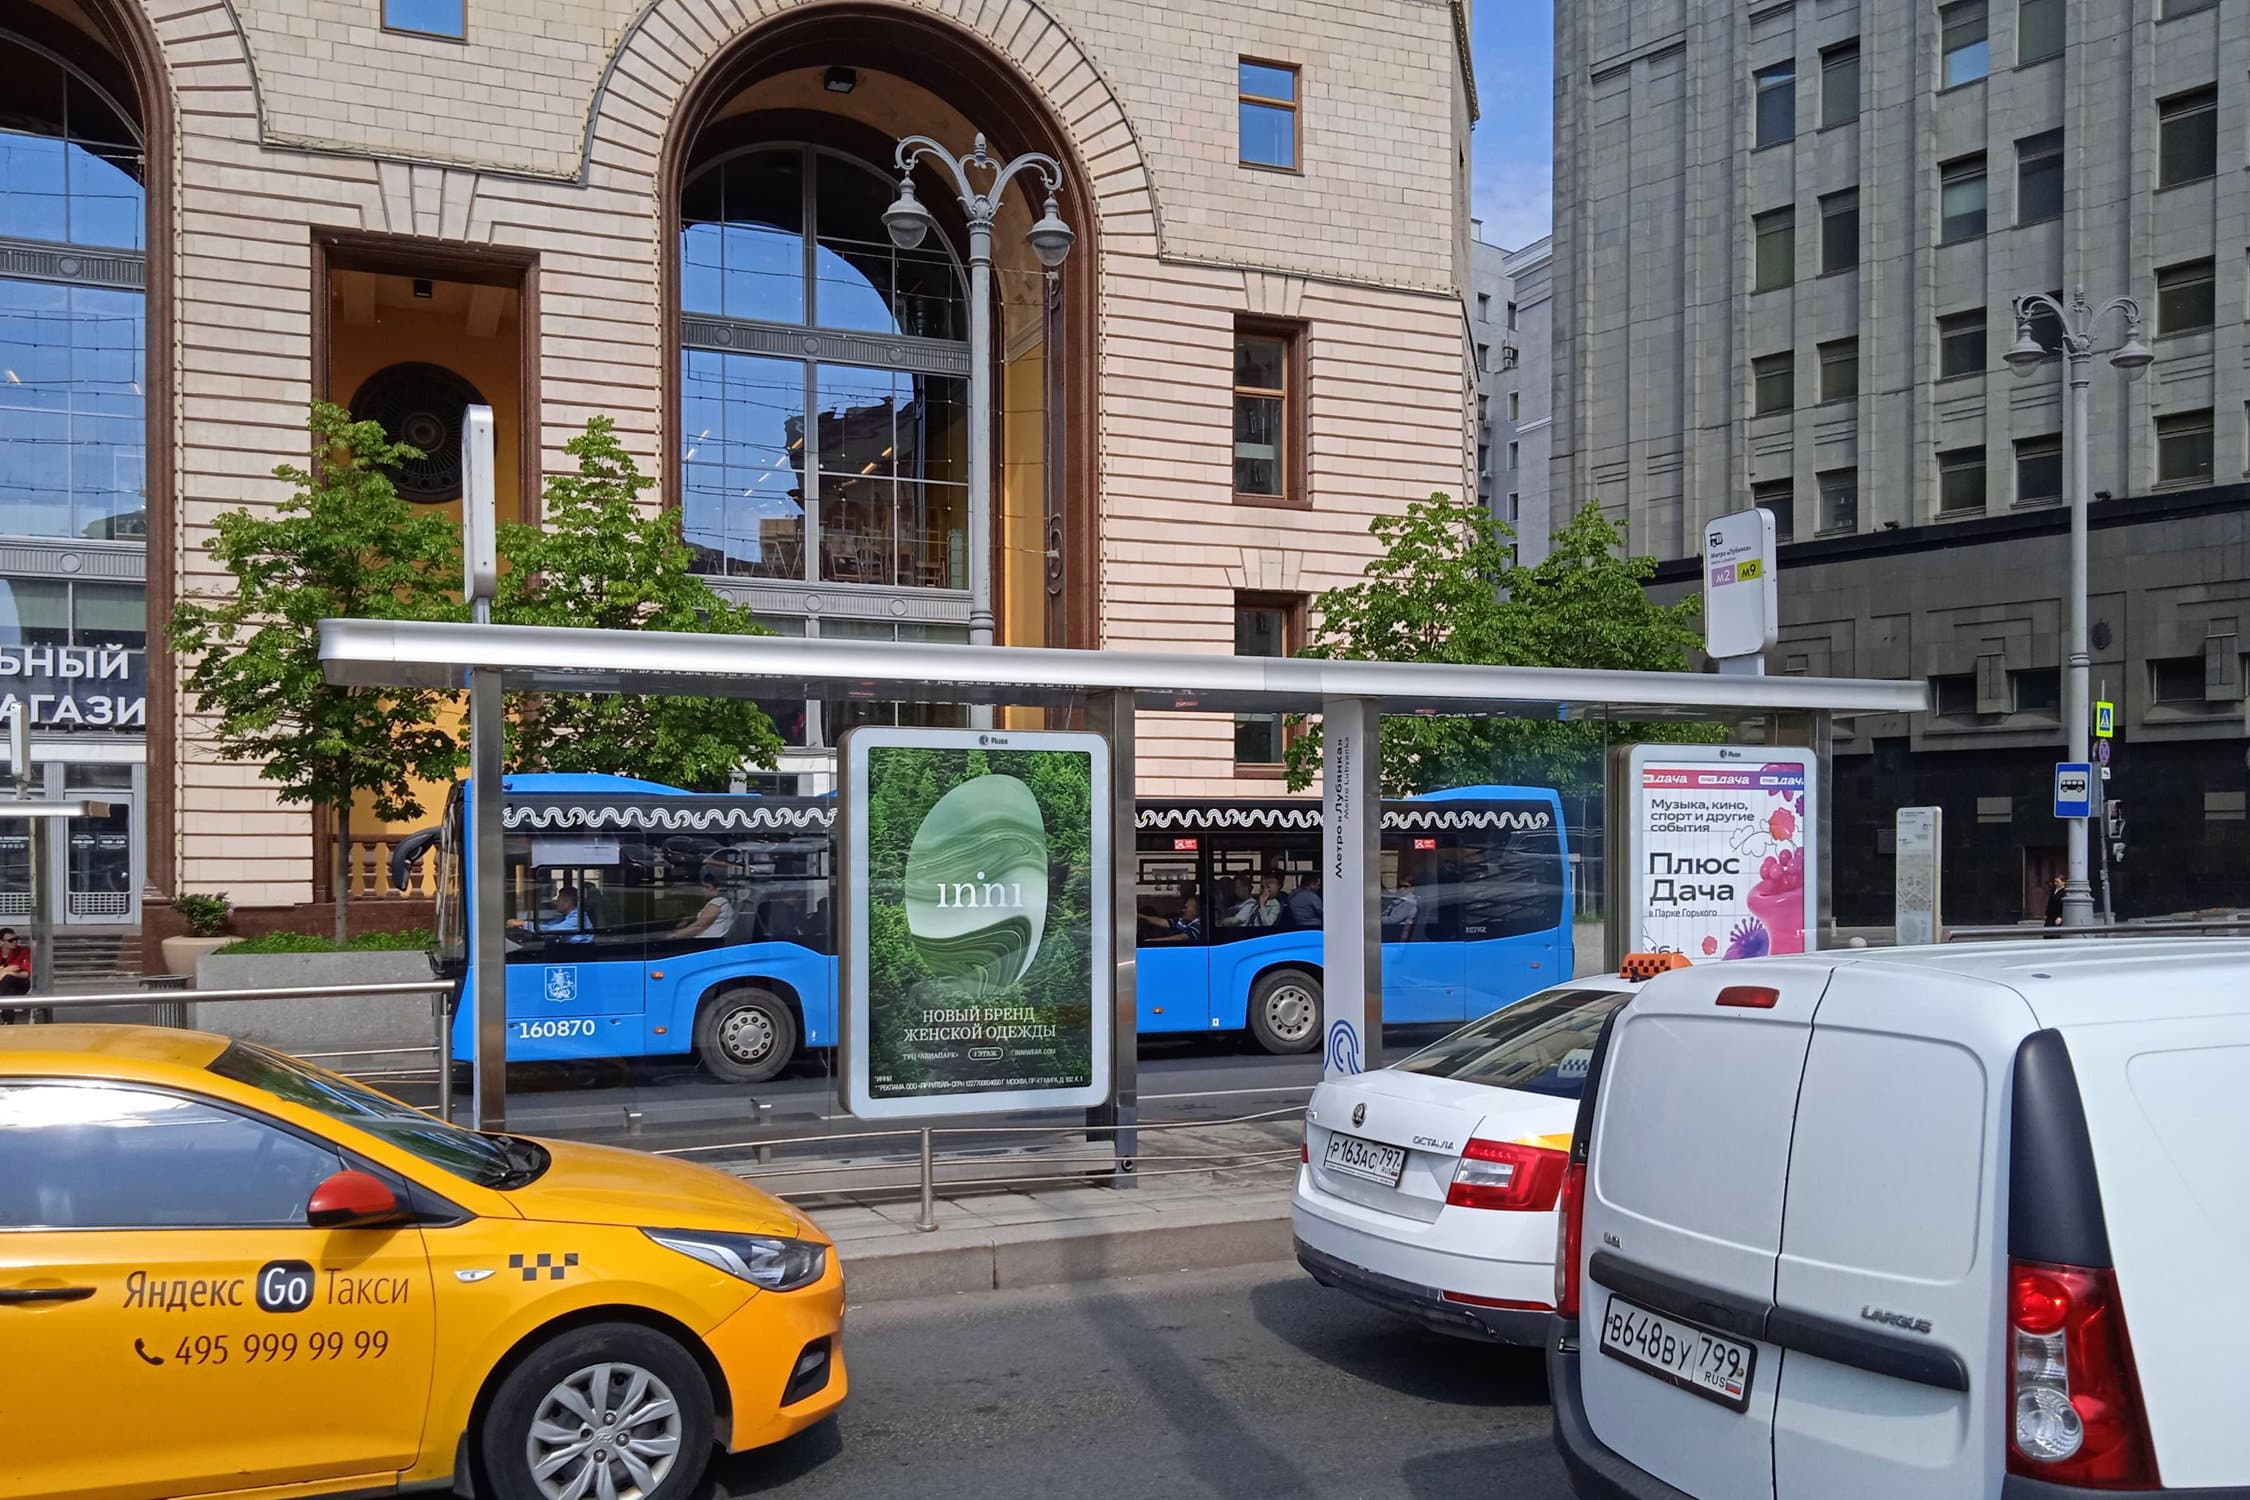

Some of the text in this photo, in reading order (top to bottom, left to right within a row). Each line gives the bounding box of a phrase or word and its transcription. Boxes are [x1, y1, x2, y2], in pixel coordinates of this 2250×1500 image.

[1335, 739, 1344, 879] Метро «Лубянка»
[1651, 799, 1749, 811] Музыка, кино,
[1651, 812, 1755, 823] спорт и другие
[1651, 822, 1710, 833] события
[1649, 852, 1740, 875] Плюс
[1649, 879, 1735, 907] Дача
[1648, 908, 1718, 919] в Парке Горького
[922, 1005, 1036, 1024] НОВЫЙ БРЕНД
[519, 1019, 596, 1039] 160870
[903, 1024, 1057, 1042] ЖЕНСКОЙ ОДЕЖДЫ
[1412, 1135, 1456, 1151] OCTAVIA
[1379, 1147, 1401, 1169] 797
[122, 1267, 409, 1312] Яндекс Go Такси
[1861, 1305, 1933, 1334] LARGUS
[175, 1330, 389, 1365] 495 999 99 99
[1610, 1311, 1742, 1379] В648ВУ 799
[1704, 1371, 1726, 1388] RUS
